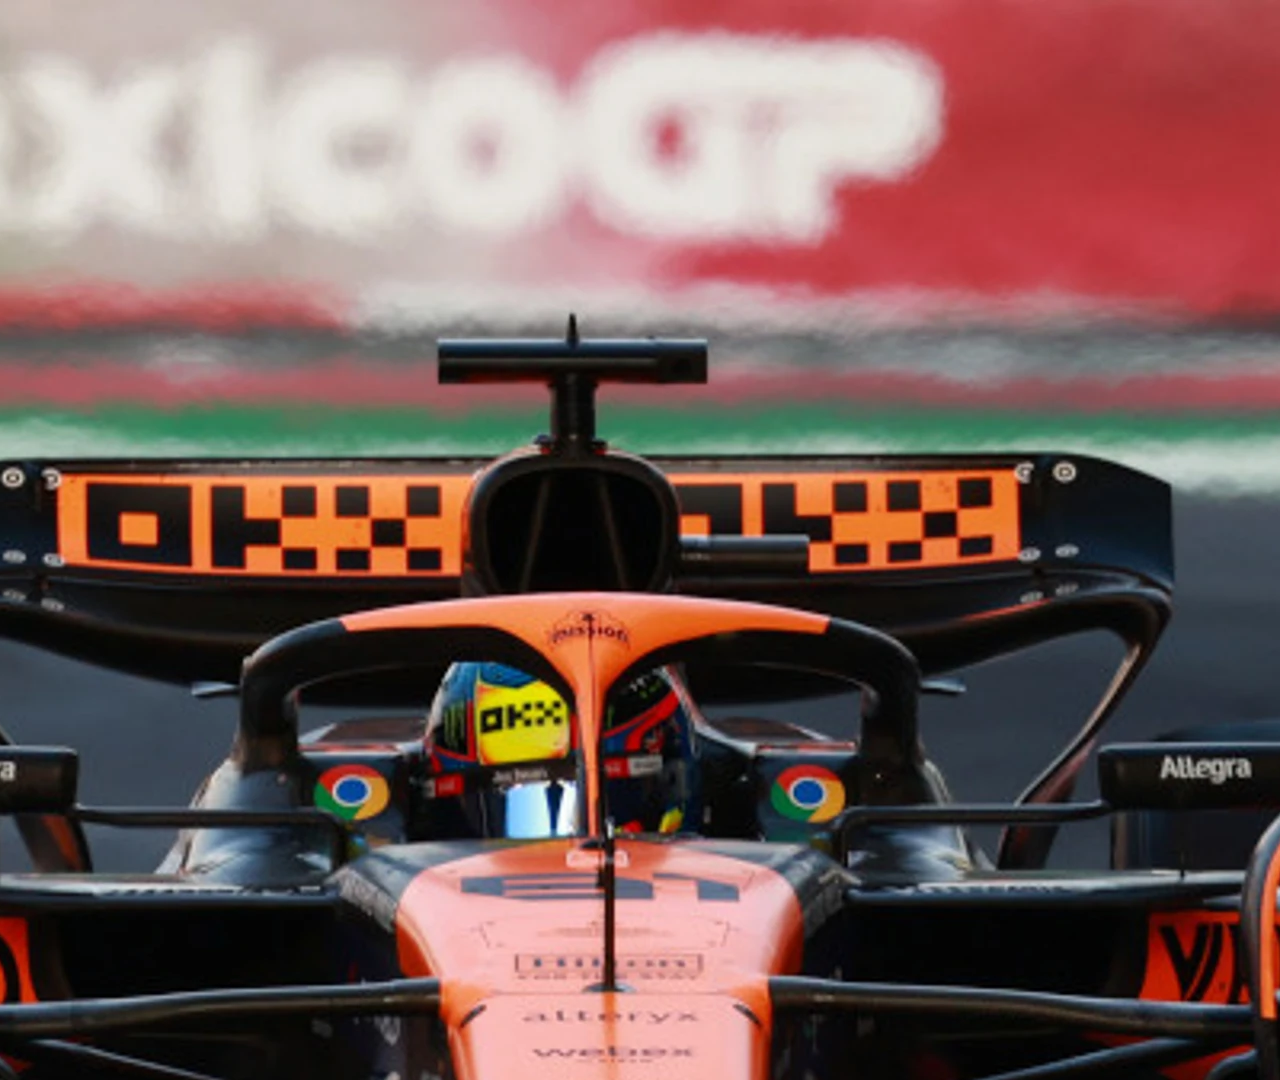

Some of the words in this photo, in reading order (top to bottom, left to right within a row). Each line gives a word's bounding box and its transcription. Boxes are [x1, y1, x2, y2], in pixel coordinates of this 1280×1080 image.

[87, 483, 442, 570] OKX
[480, 701, 562, 733] OKX
[1160, 754, 1253, 785] Allegra
[532, 956, 687, 970] Hilon
[522, 1009, 697, 1025] alteryx
[532, 1045, 694, 1058] webex
